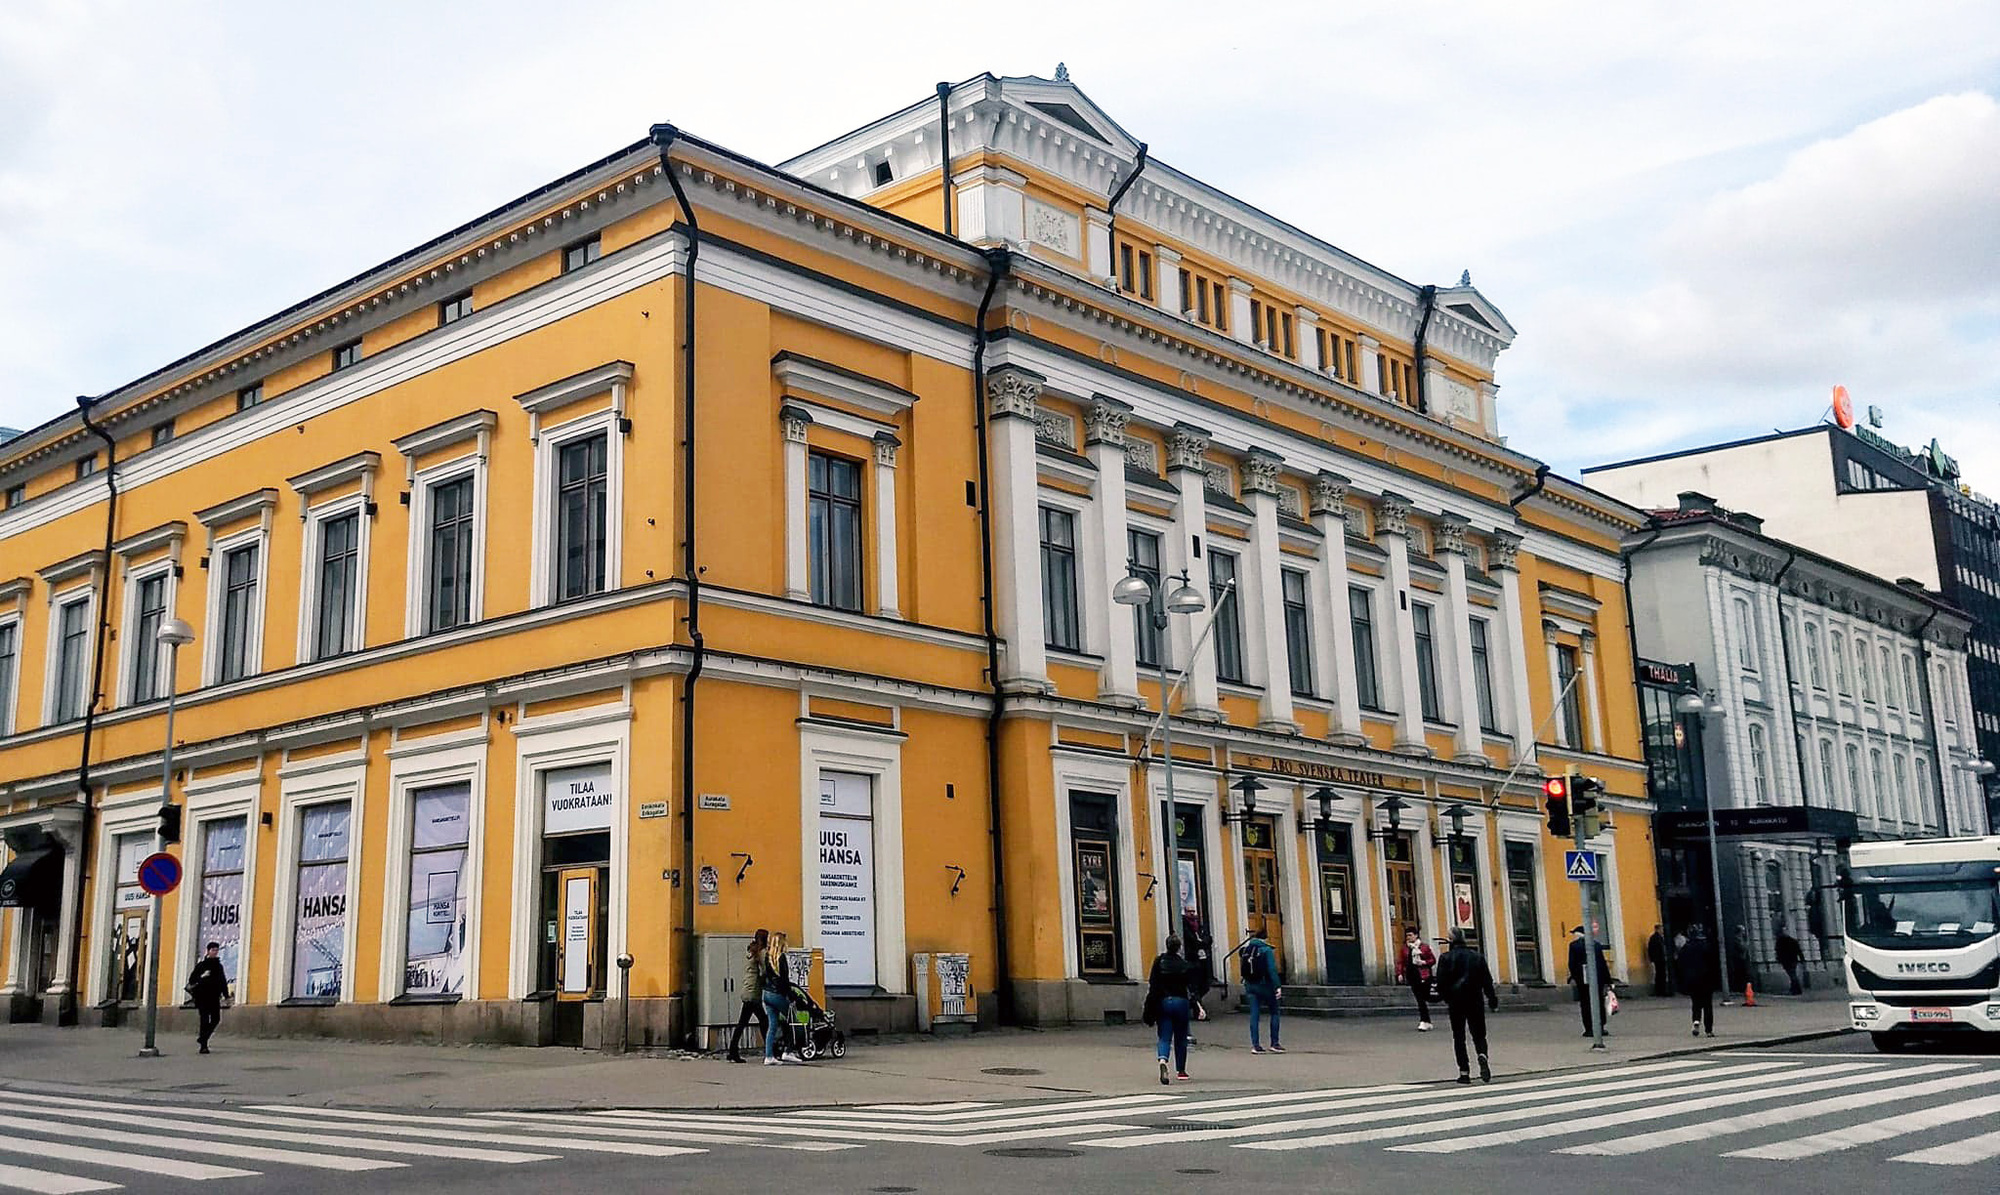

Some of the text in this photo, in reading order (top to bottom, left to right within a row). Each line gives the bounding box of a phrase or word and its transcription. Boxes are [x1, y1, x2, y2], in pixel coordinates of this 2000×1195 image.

[1648, 665, 1679, 684] THALIA
[1299, 764, 1344, 782] SVENSKA
[1349, 769, 1385, 787] TEATER
[570, 781, 594, 795] TILAA
[552, 793, 612, 811] VUOKRATAAN!
[819, 830, 848, 848] UUSI
[819, 848, 862, 866] HANSA
[1082, 854, 1103, 867] EYRE
[210, 904, 240, 926] UUSI
[302, 895, 346, 918] HANSA
[1897, 962, 1951, 973] IVECO
